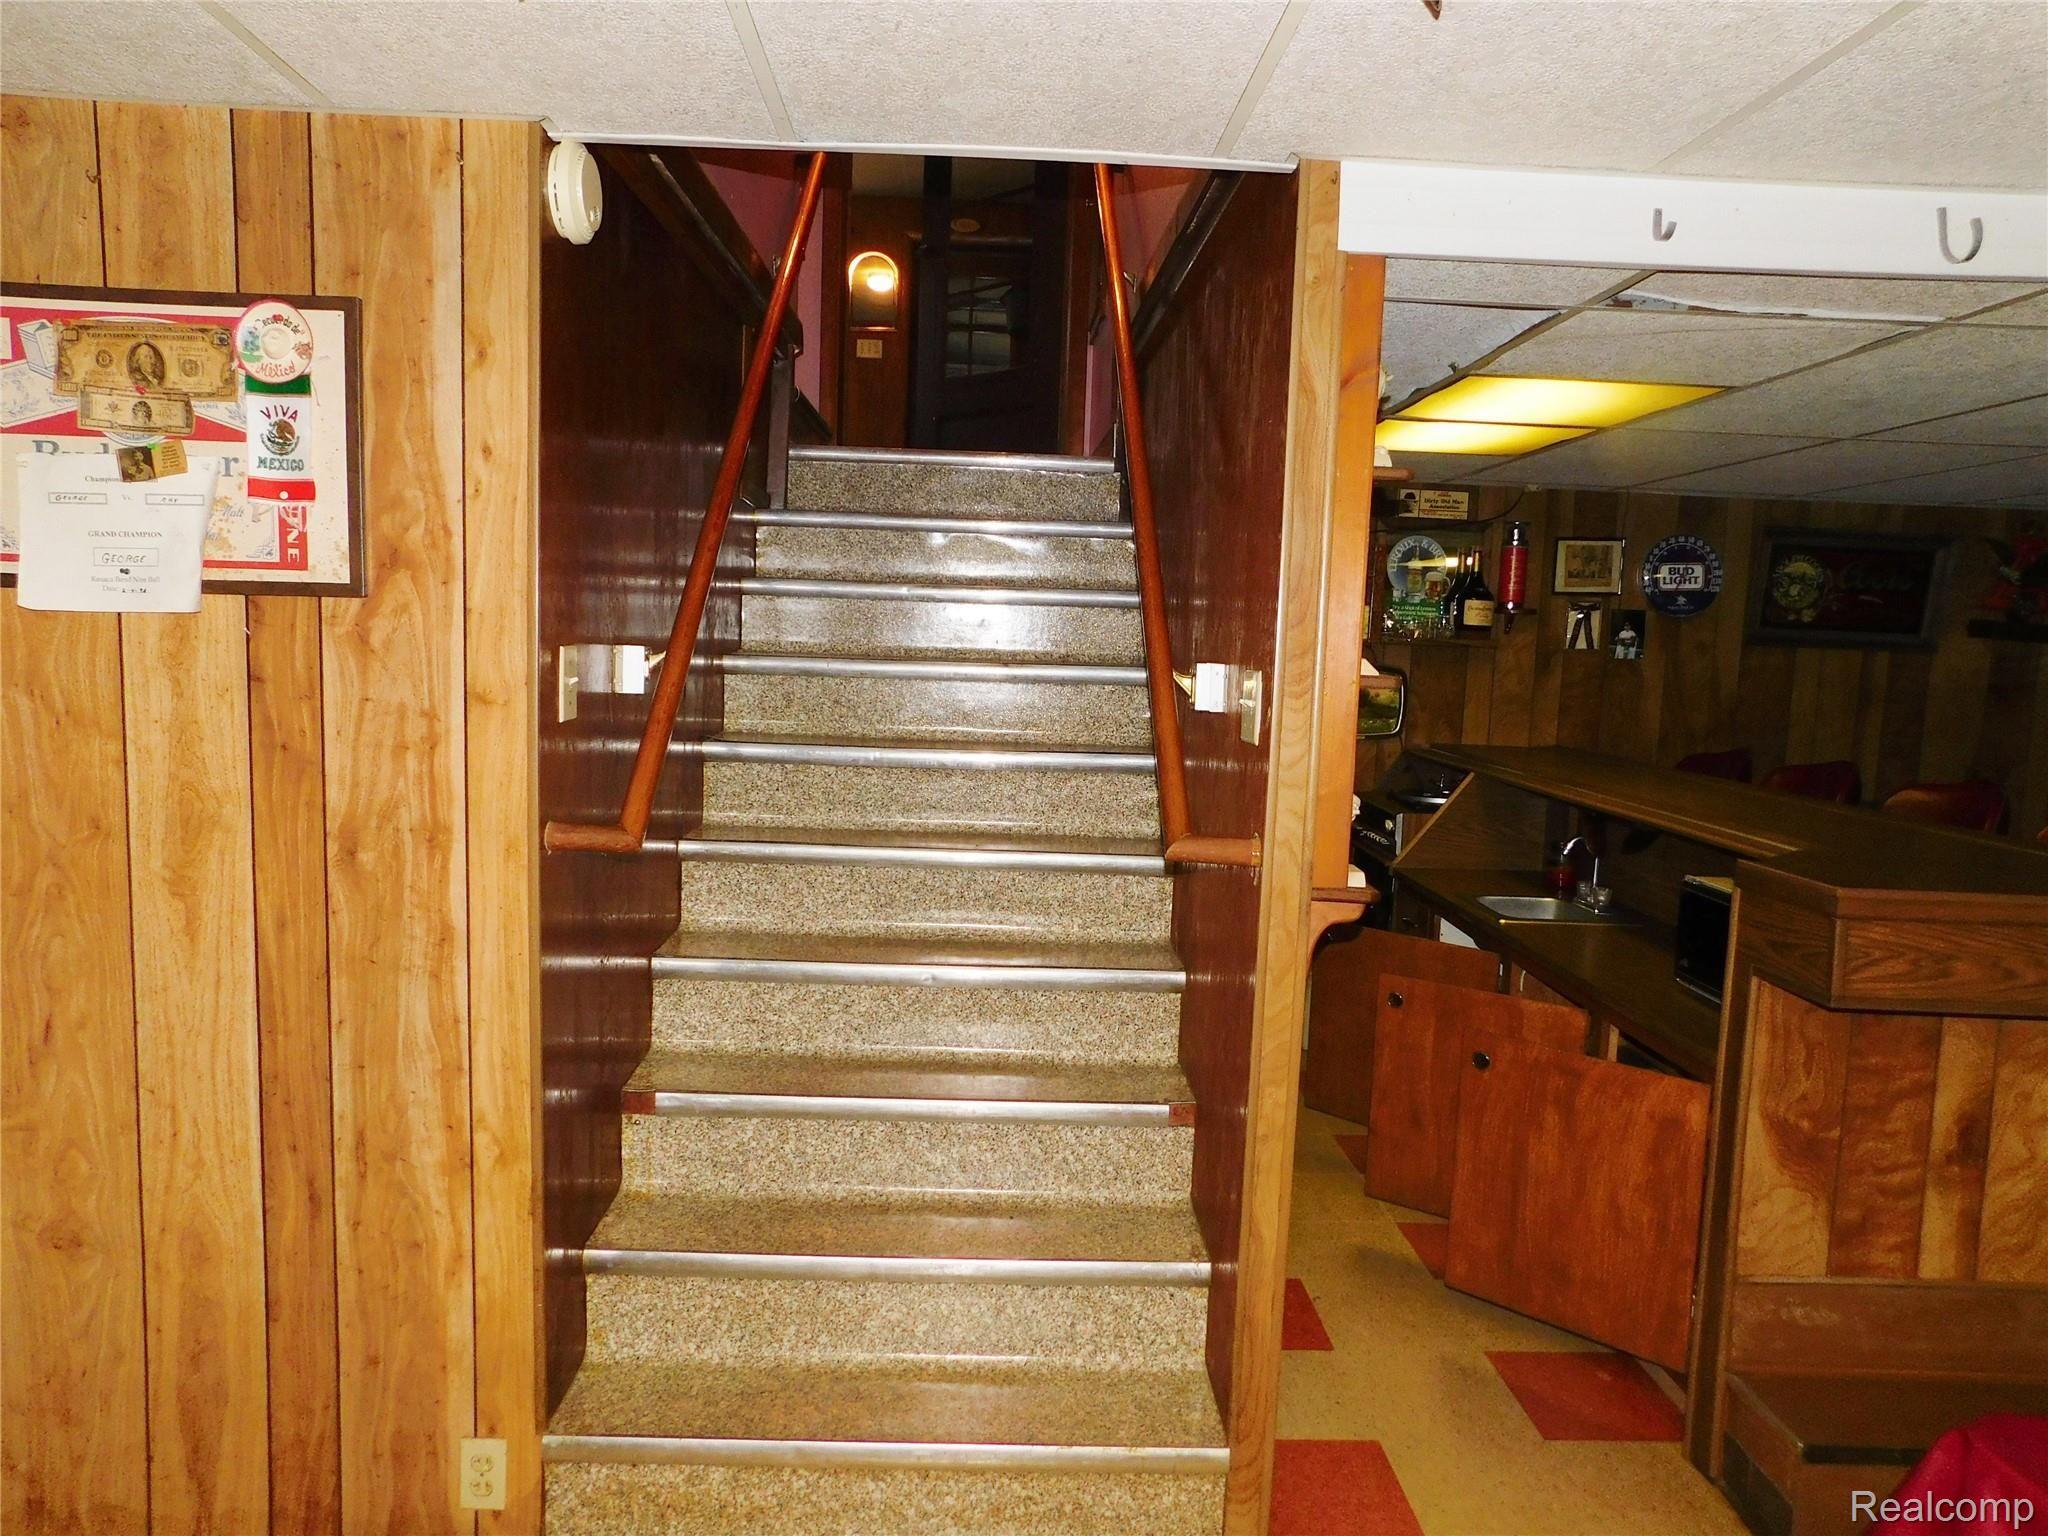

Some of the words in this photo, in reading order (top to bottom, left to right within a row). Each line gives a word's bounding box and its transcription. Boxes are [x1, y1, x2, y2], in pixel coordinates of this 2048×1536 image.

[260, 404, 299, 423] VIVA
[257, 456, 305, 472] MEXICO
[88, 530, 116, 538] GRAND
[118, 530, 162, 538] CHAMPION
[101, 552, 147, 564] GEORGE
[1668, 567, 1695, 576] BUD
[1662, 576, 1700, 585] LIGHT
